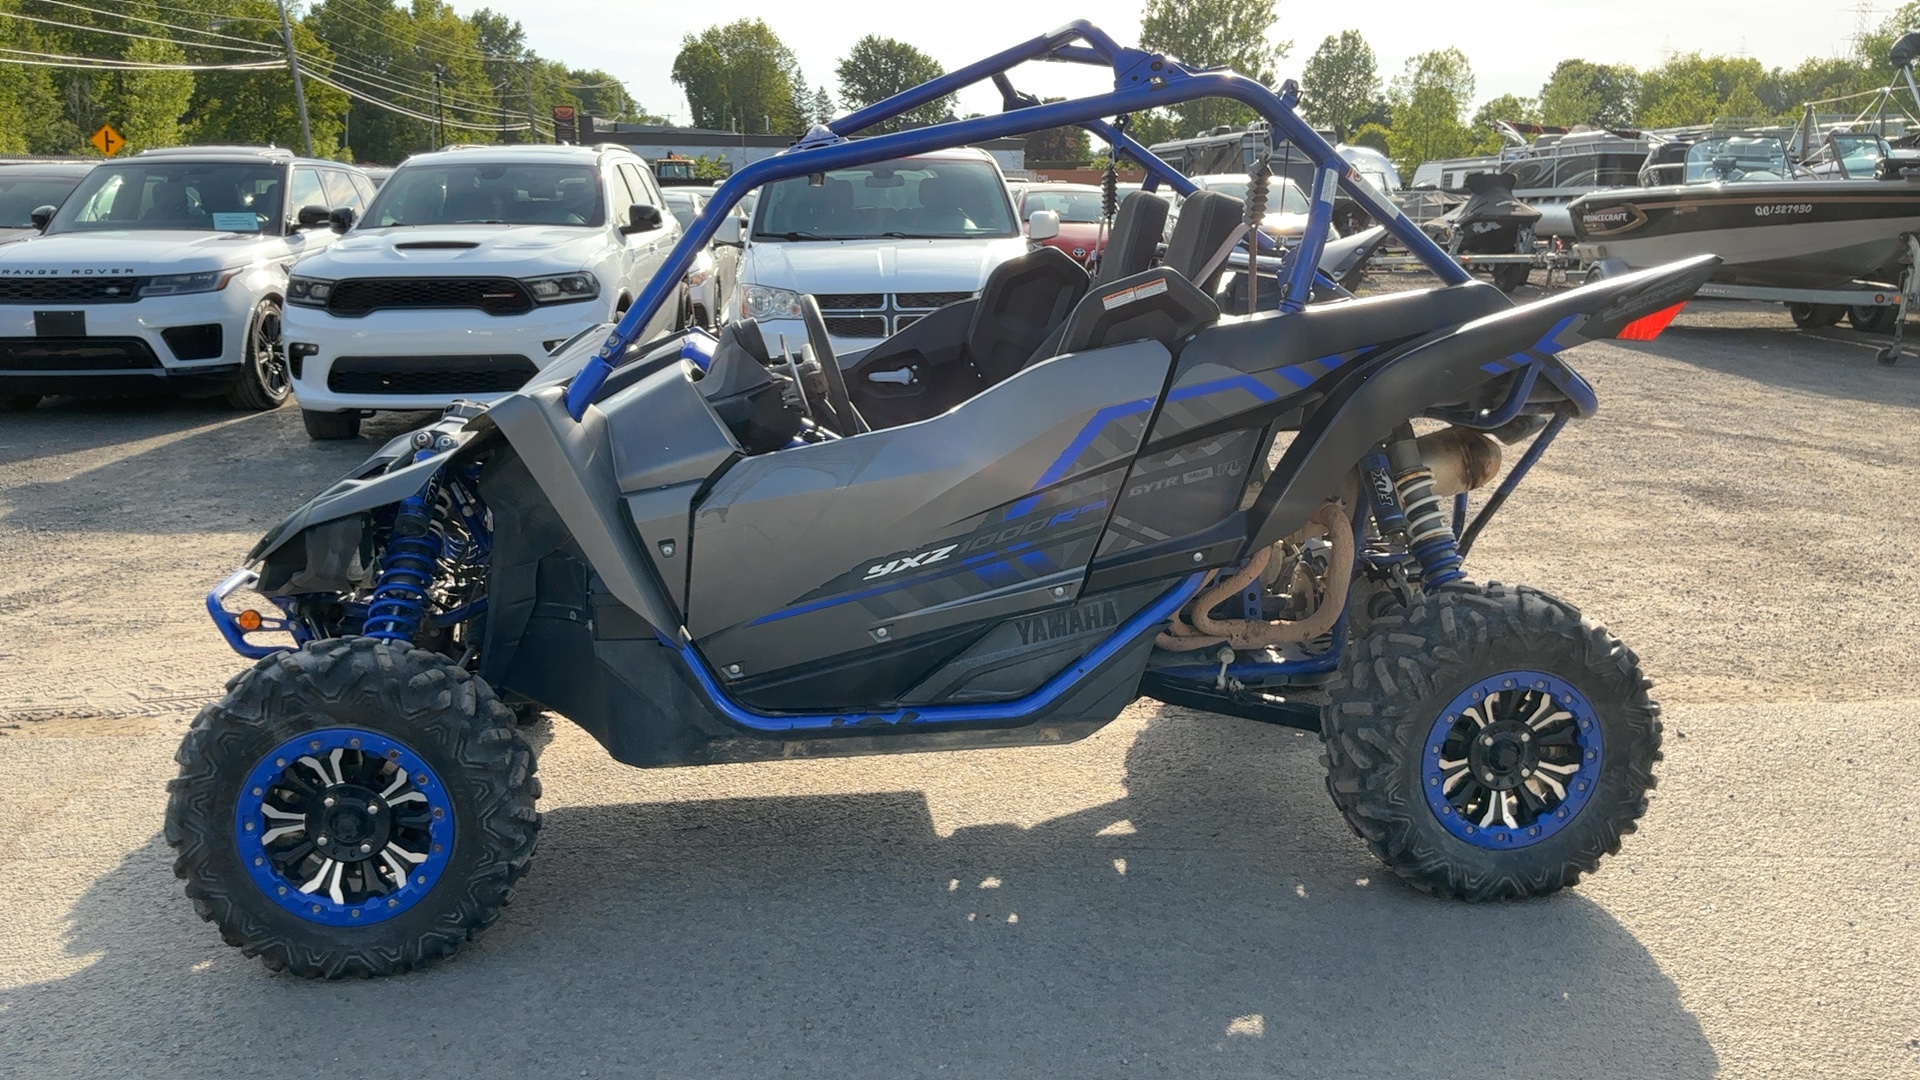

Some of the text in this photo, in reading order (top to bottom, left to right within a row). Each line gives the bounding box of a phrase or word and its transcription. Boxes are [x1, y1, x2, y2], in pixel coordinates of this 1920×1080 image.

[1582, 212, 1628, 222] PRINCECRAFT
[1128, 475, 1180, 499] GYTR
[1370, 467, 1394, 506] FOX
[1014, 600, 1118, 646] YAMAHA
